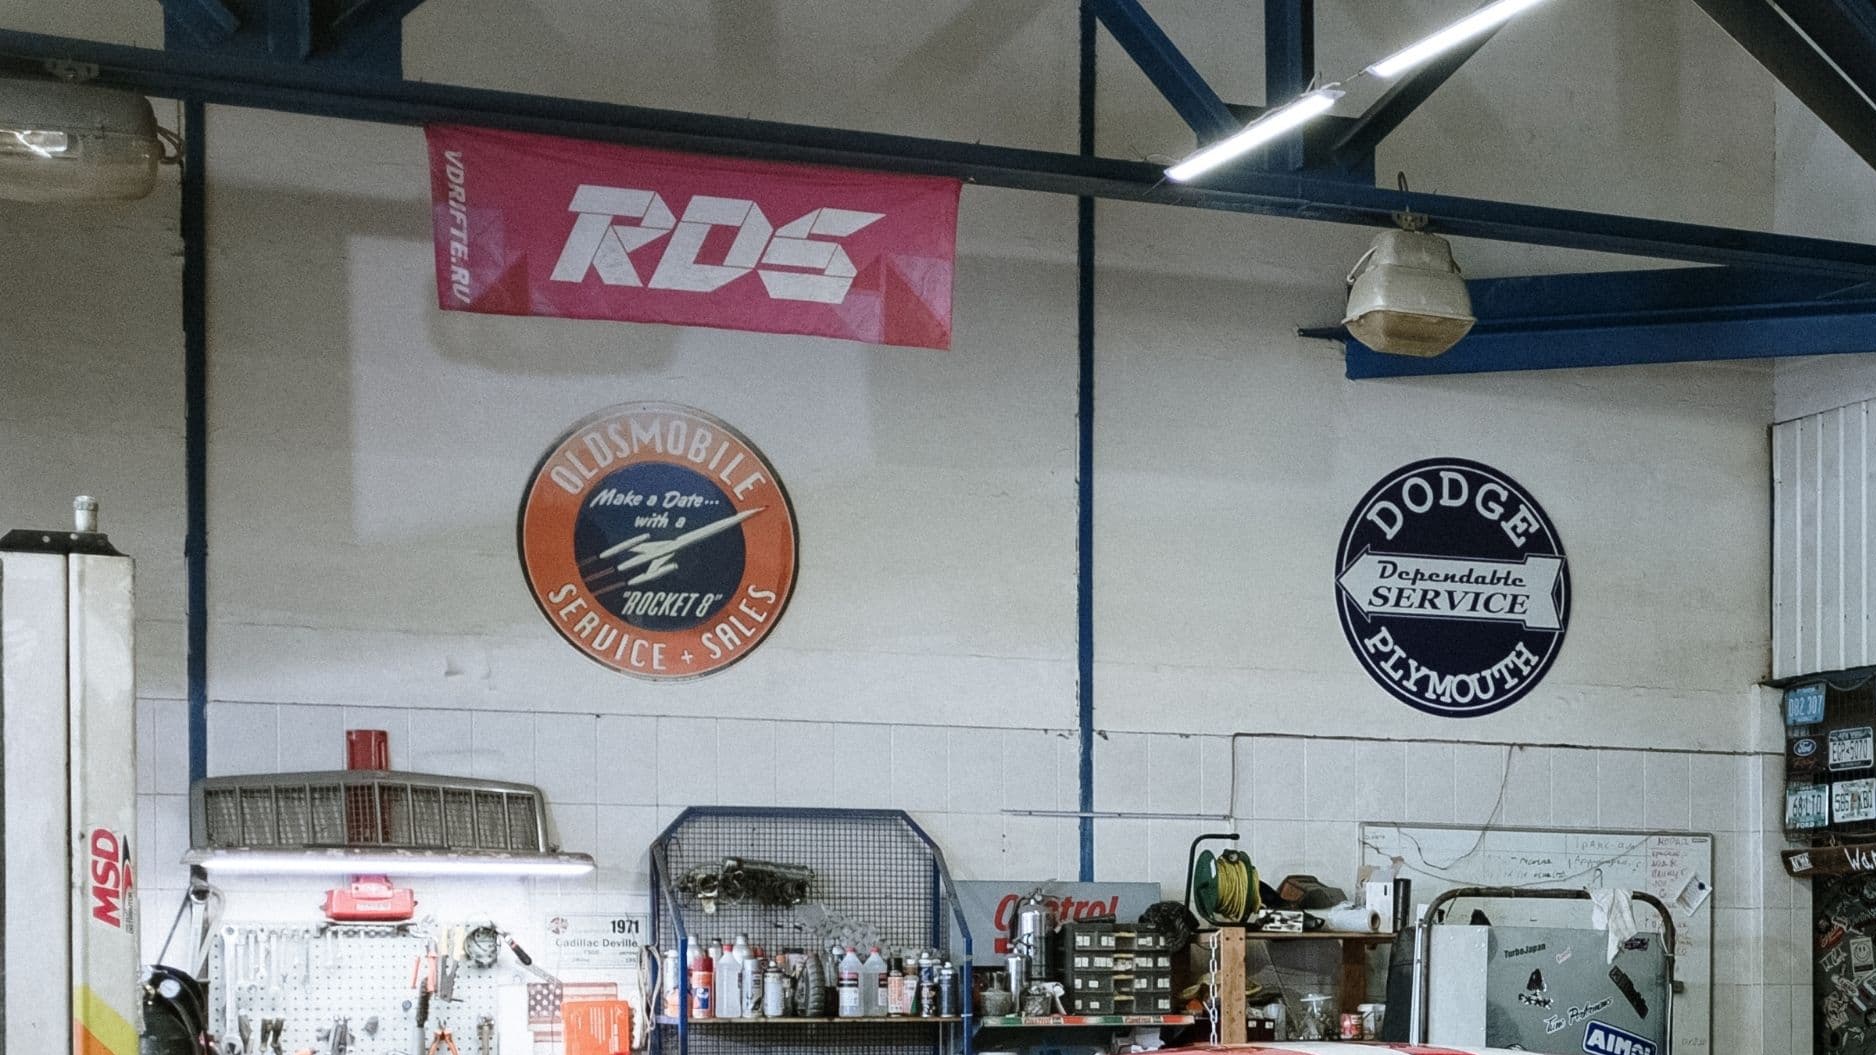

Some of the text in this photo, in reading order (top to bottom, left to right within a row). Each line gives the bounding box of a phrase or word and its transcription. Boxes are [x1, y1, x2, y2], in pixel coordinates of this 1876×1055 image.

[444, 150, 472, 304] VDRIFTE.RU
[549, 184, 887, 305] RDS
[550, 417, 767, 501] OLDSMOBILE
[589, 487, 642, 508] Make
[646, 494, 656, 506] a
[634, 512, 686, 529] with a
[1366, 471, 1541, 548] DODGE
[1367, 586, 1530, 615] SERVICE
[1377, 560, 1528, 588] Dependable
[548, 583, 667, 671] SERVICE
[701, 584, 777, 660] SALES
[1364, 626, 1540, 704] PLYMOUTH
[91, 828, 121, 929] MSD
[555, 938, 638, 948] Cadillac Deville
[610, 919, 639, 934] 1971
[1504, 943, 1546, 959] TurboJapan
